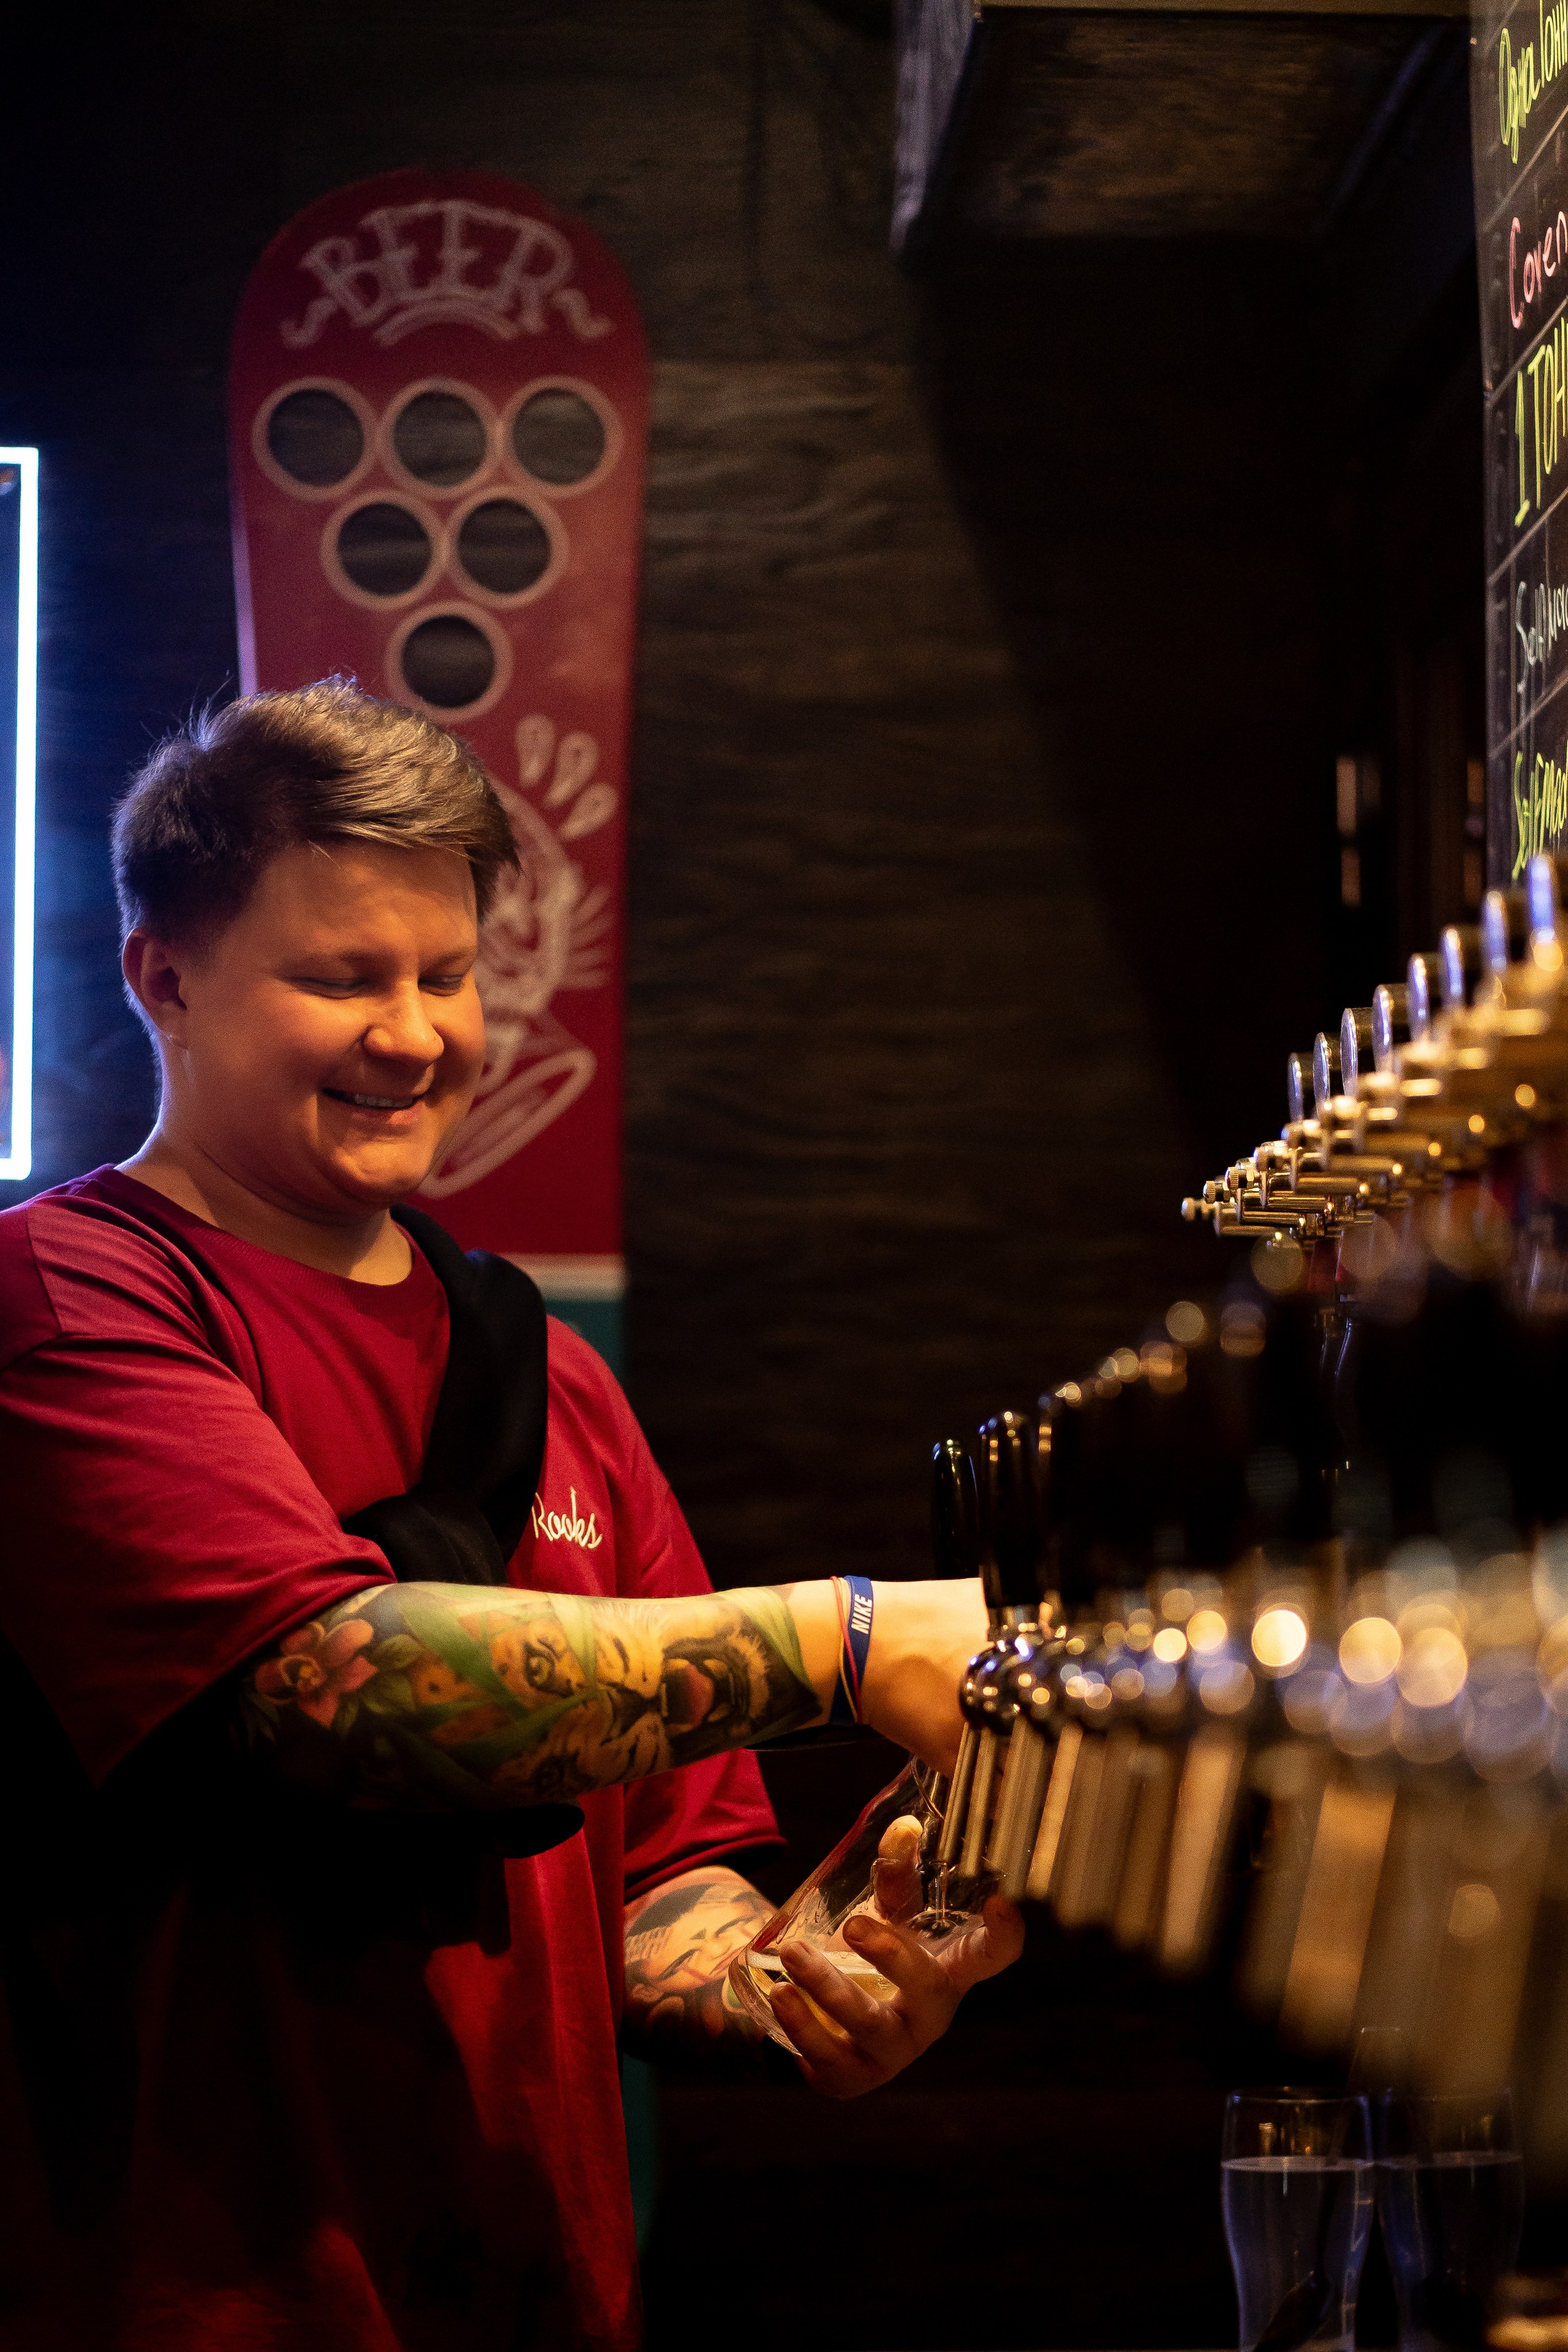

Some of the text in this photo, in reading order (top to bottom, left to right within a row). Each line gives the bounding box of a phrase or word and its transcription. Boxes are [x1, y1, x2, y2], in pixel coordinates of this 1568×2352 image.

[298, 198, 574, 336] BEER
[1528, 317, 1568, 510] ТОН
[851, 1594, 873, 1635] NIKE
